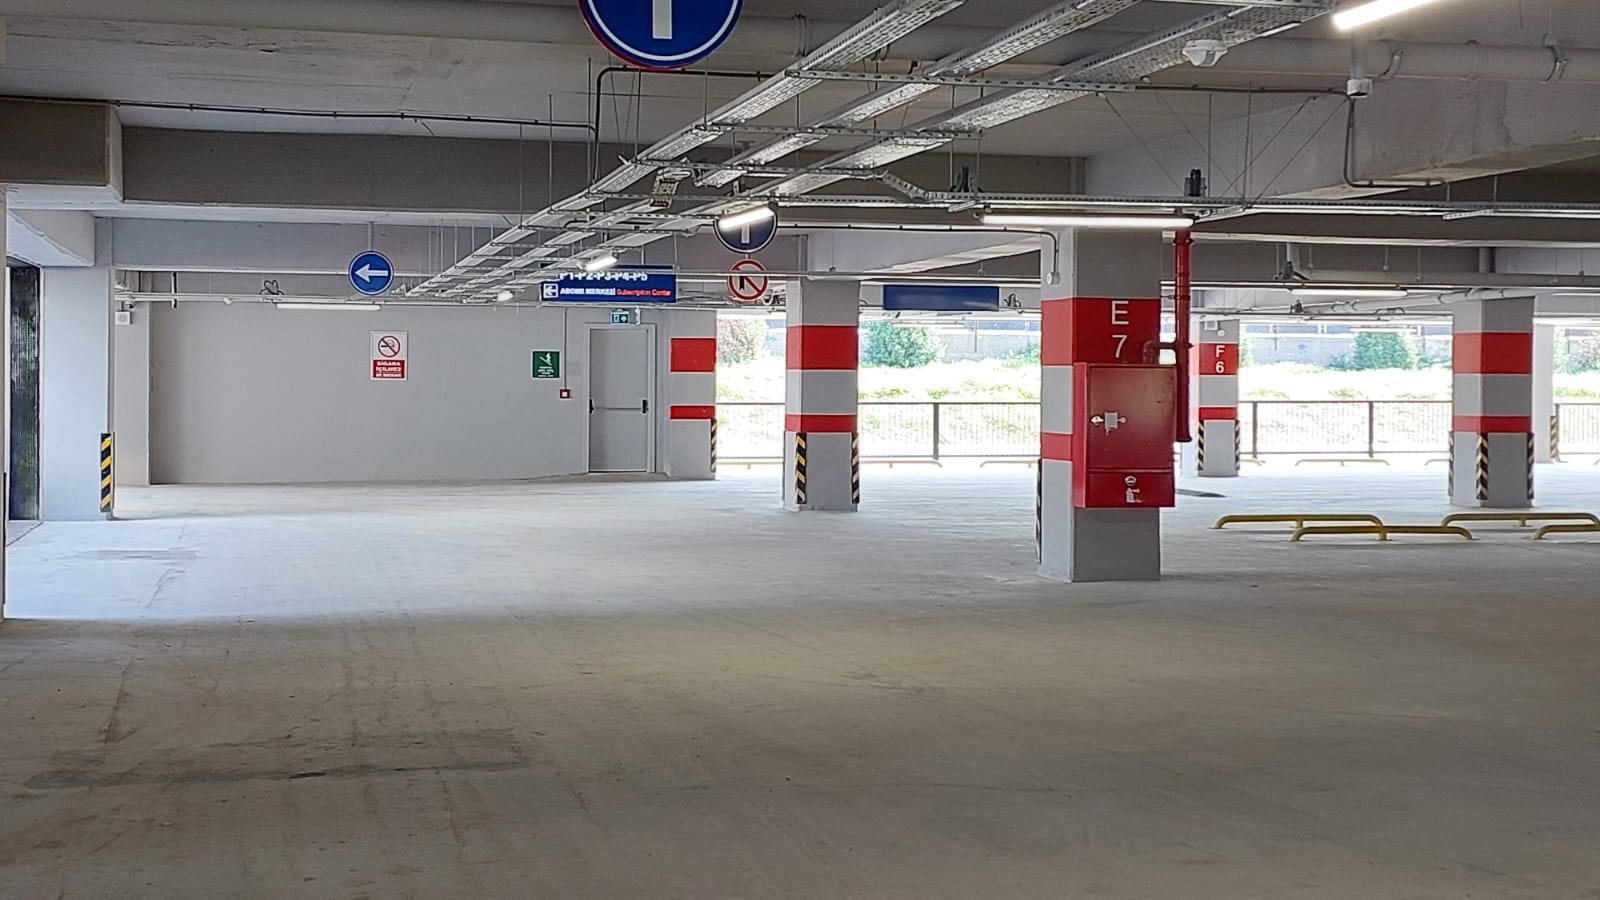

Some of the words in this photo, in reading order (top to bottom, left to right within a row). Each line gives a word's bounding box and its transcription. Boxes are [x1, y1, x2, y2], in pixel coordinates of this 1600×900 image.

[1111, 300, 1129, 325] E
[1111, 334, 1128, 359] 7
[1215, 345, 1226, 358] F
[1215, 361, 1225, 374] 6
